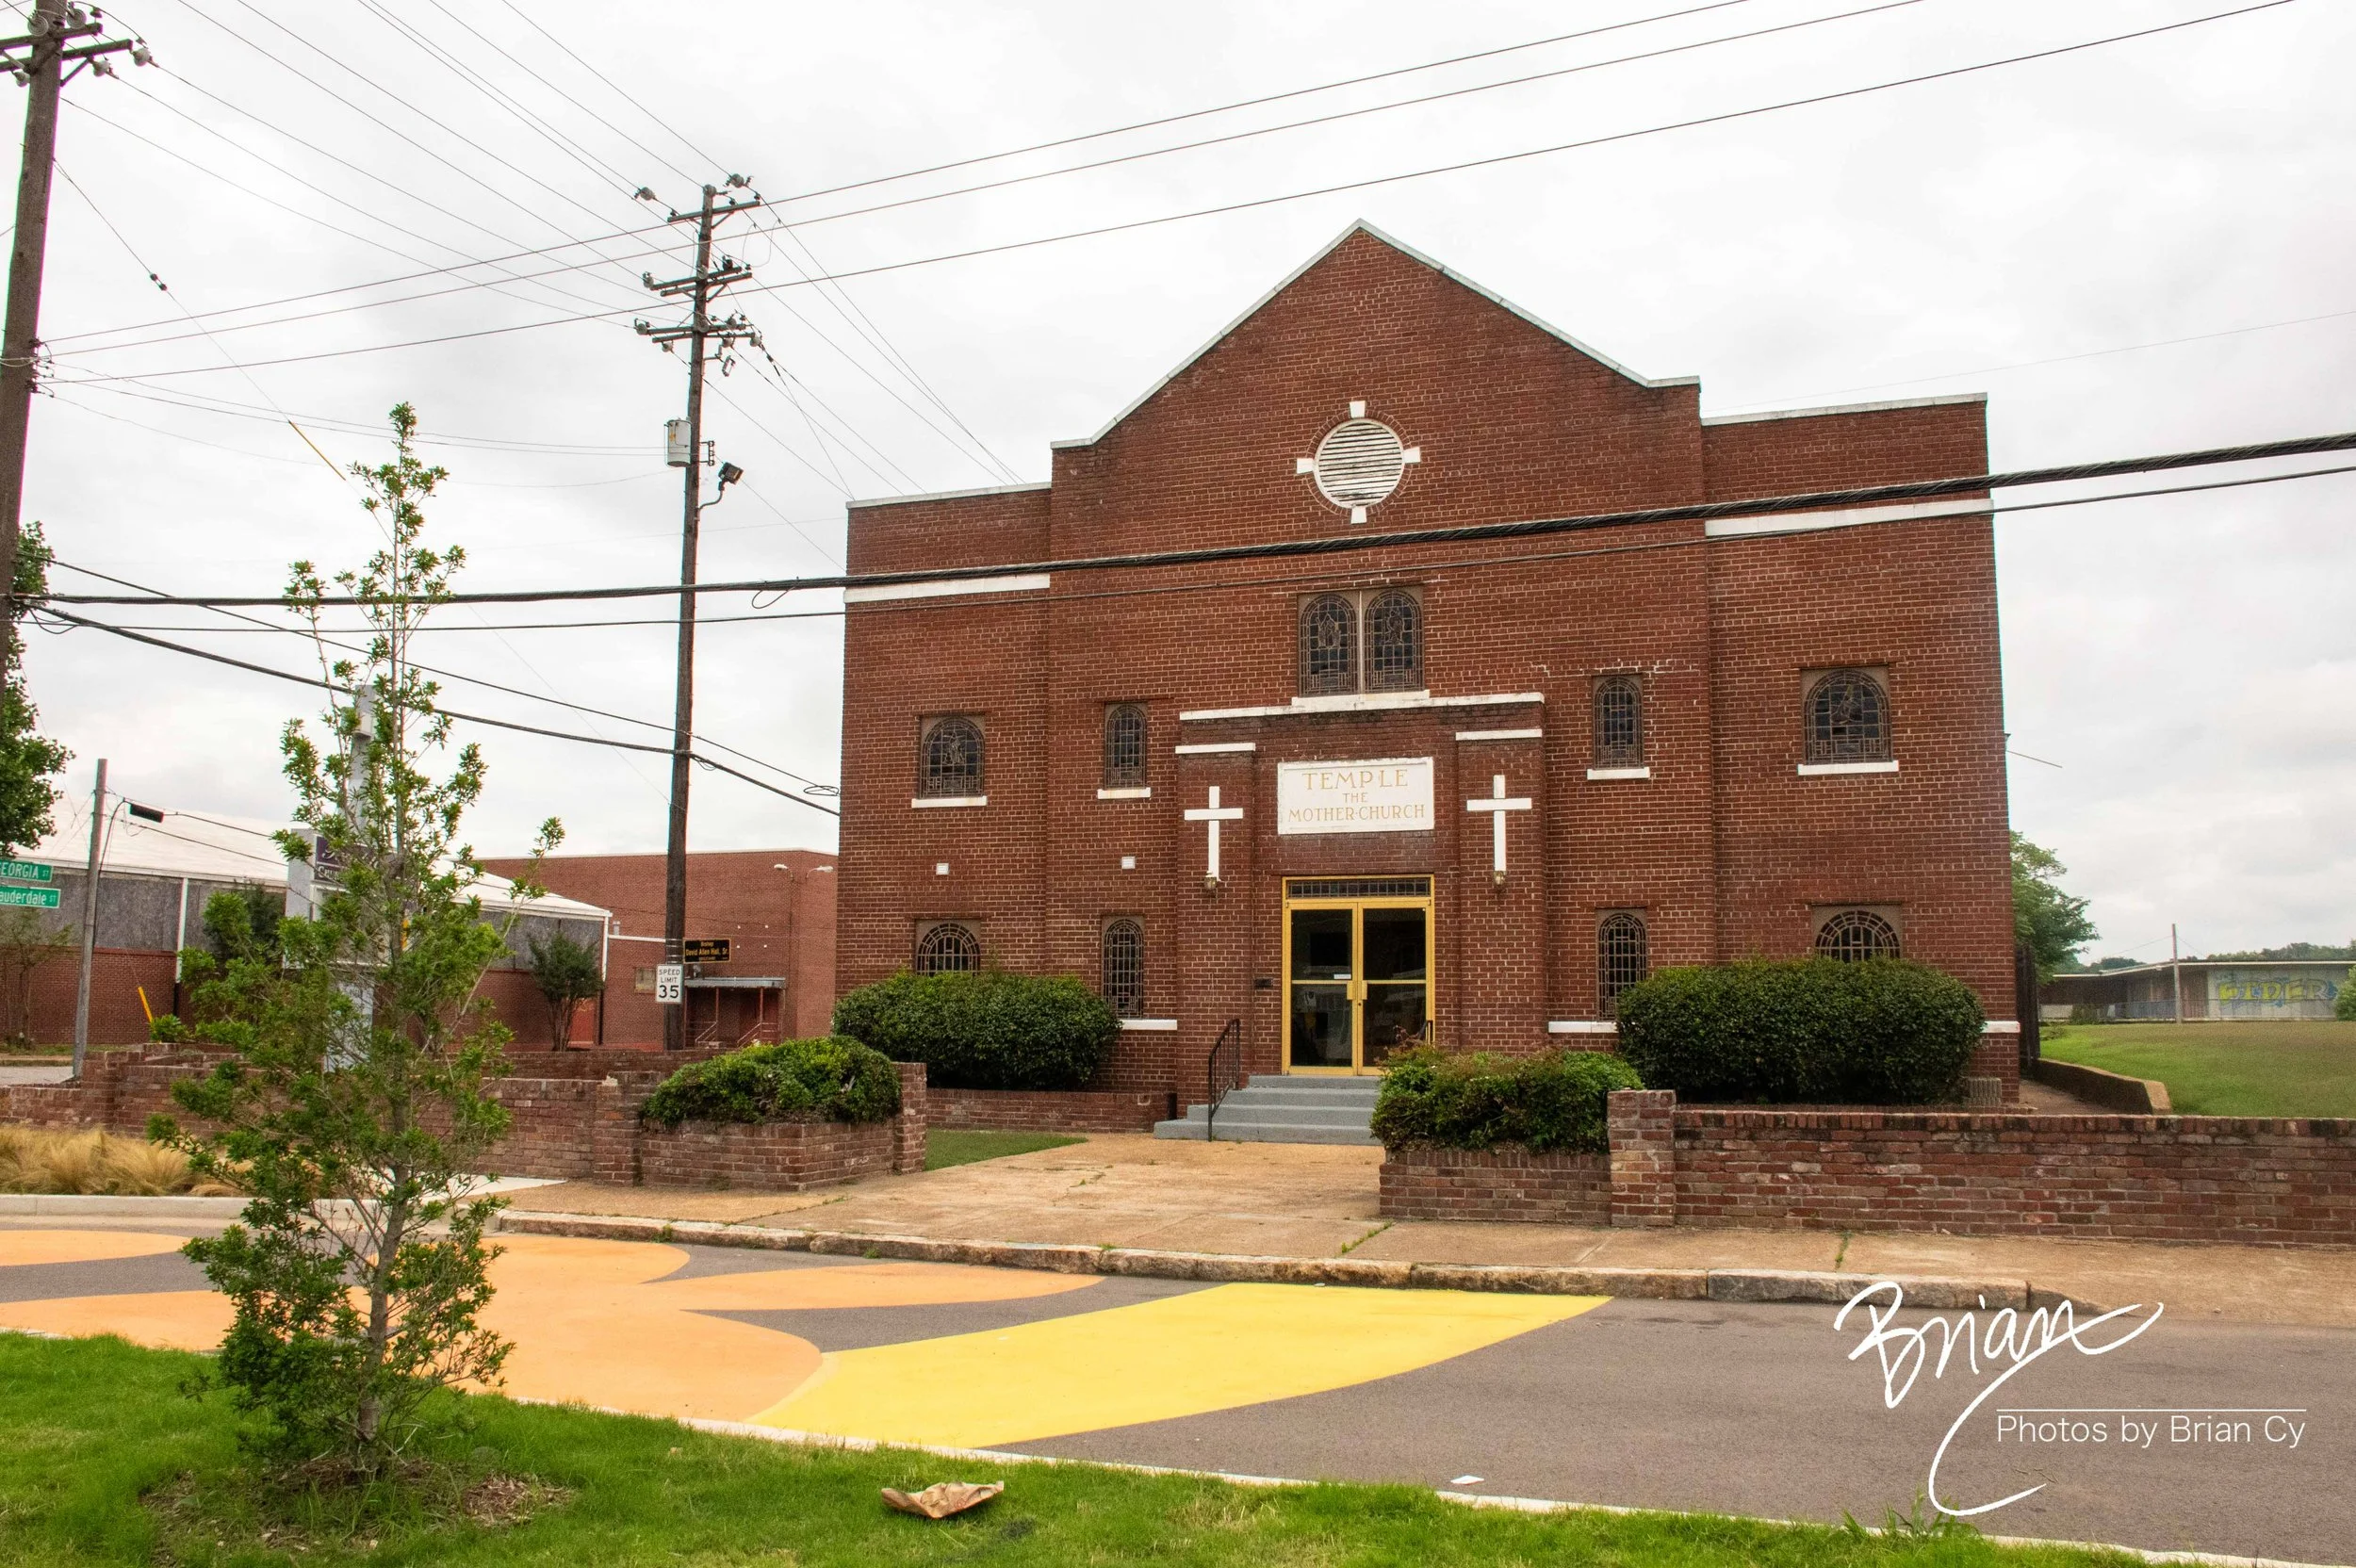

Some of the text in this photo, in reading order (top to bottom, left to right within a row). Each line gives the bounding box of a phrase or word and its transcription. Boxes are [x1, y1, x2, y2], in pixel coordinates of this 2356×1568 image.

[1301, 769, 1408, 790] TEMPLE
[1342, 792, 1368, 803] THE
[0, 861, 39, 878] EORGIA
[0, 890, 46, 905] auderdale
[659, 985, 679, 999] 35
